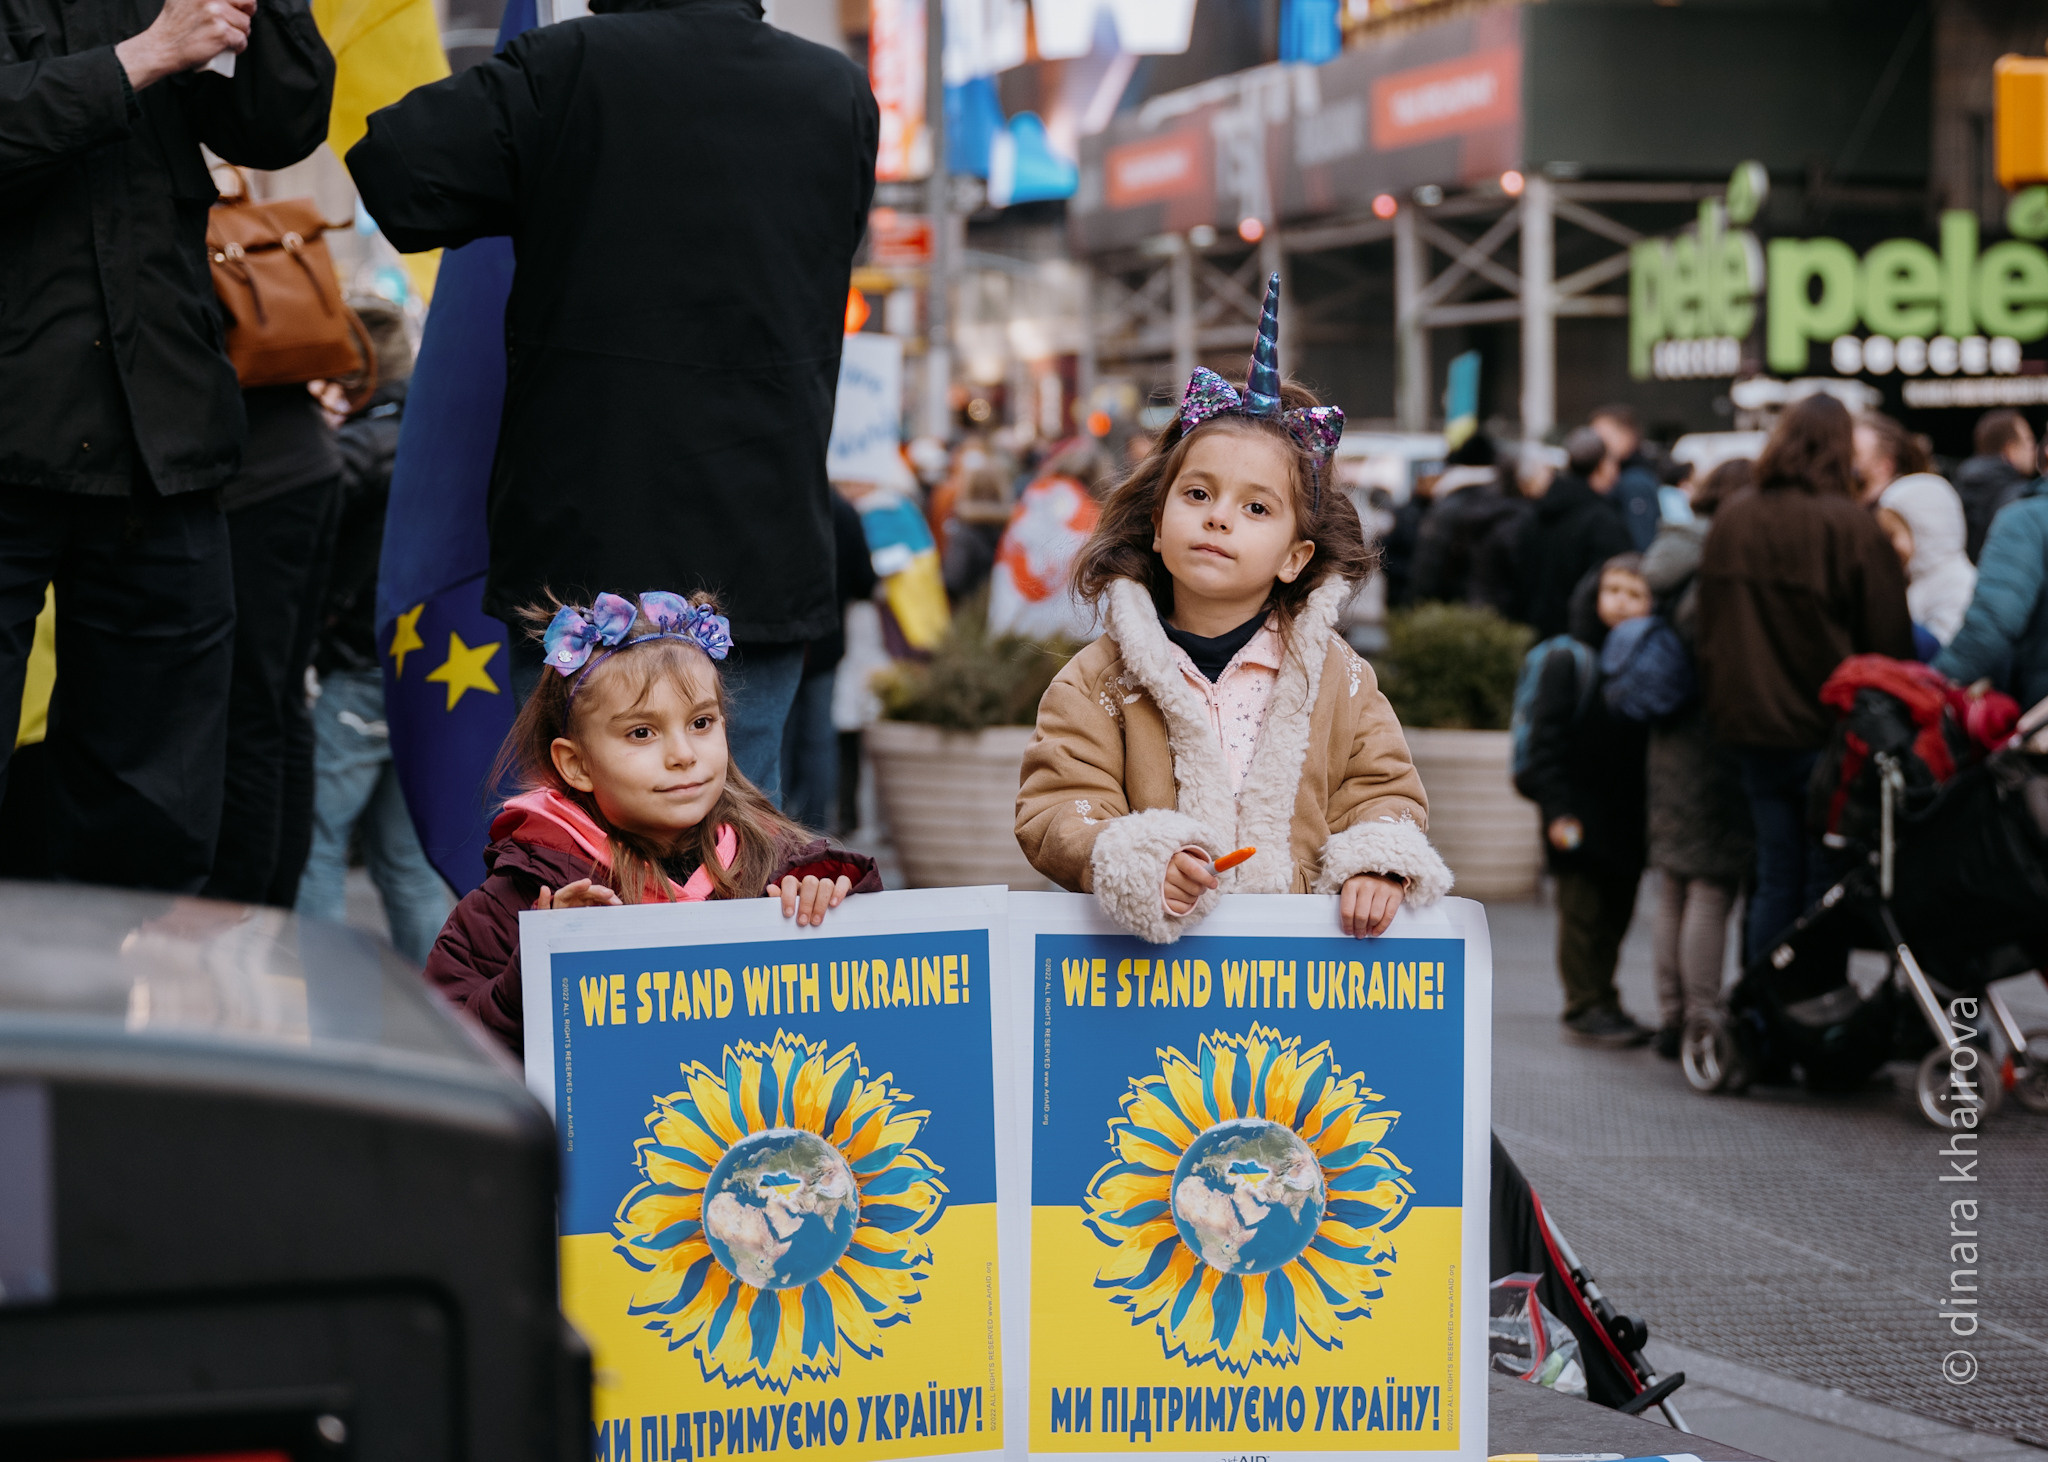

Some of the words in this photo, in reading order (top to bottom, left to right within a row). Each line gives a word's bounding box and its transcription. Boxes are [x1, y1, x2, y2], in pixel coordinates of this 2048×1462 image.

[579, 973, 627, 1027] WE
[637, 968, 734, 1024] STAND
[743, 962, 820, 1017] WITH
[829, 954, 970, 1012] UKRAINE!
[1061, 957, 1107, 1007] WE
[1116, 958, 1212, 1008] STAND
[1221, 959, 1297, 1009] WITH
[1307, 960, 1445, 1010] UKRAINE!
[565, 1050, 573, 1094] RESERVED
[590, 1418, 631, 1462] МИ
[641, 1397, 849, 1462] ПІДТРИМУЄМО
[856, 1380, 983, 1443] УКРАЇНУ!
[1051, 1386, 1092, 1433] МИ
[1101, 1385, 1306, 1443] ПІДТРИМУЄМО
[1314, 1376, 1440, 1432] УКРАЇНУ!
